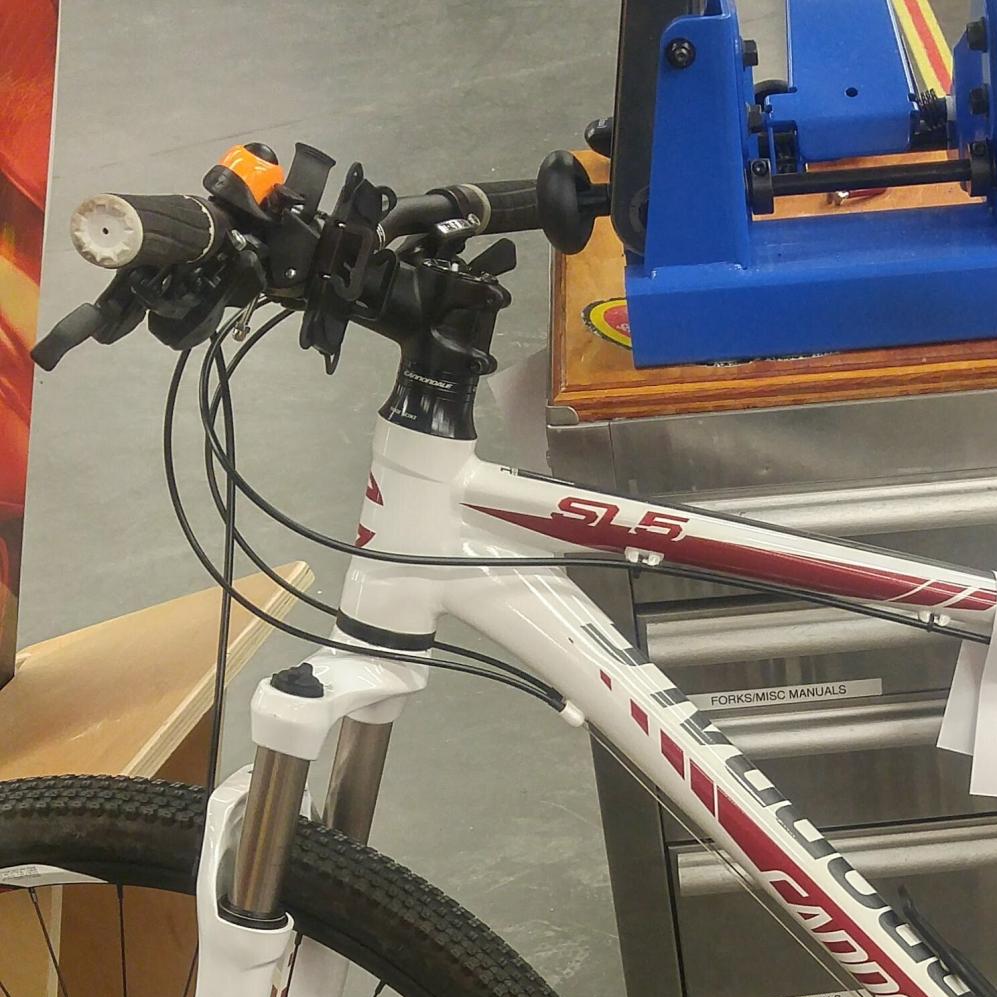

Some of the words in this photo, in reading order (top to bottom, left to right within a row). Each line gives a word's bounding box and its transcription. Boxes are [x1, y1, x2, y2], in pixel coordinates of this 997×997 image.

[551, 497, 689, 541] SL5
[711, 690, 786, 706] FORKS/MISC
[789, 684, 847, 699] MANUALS
